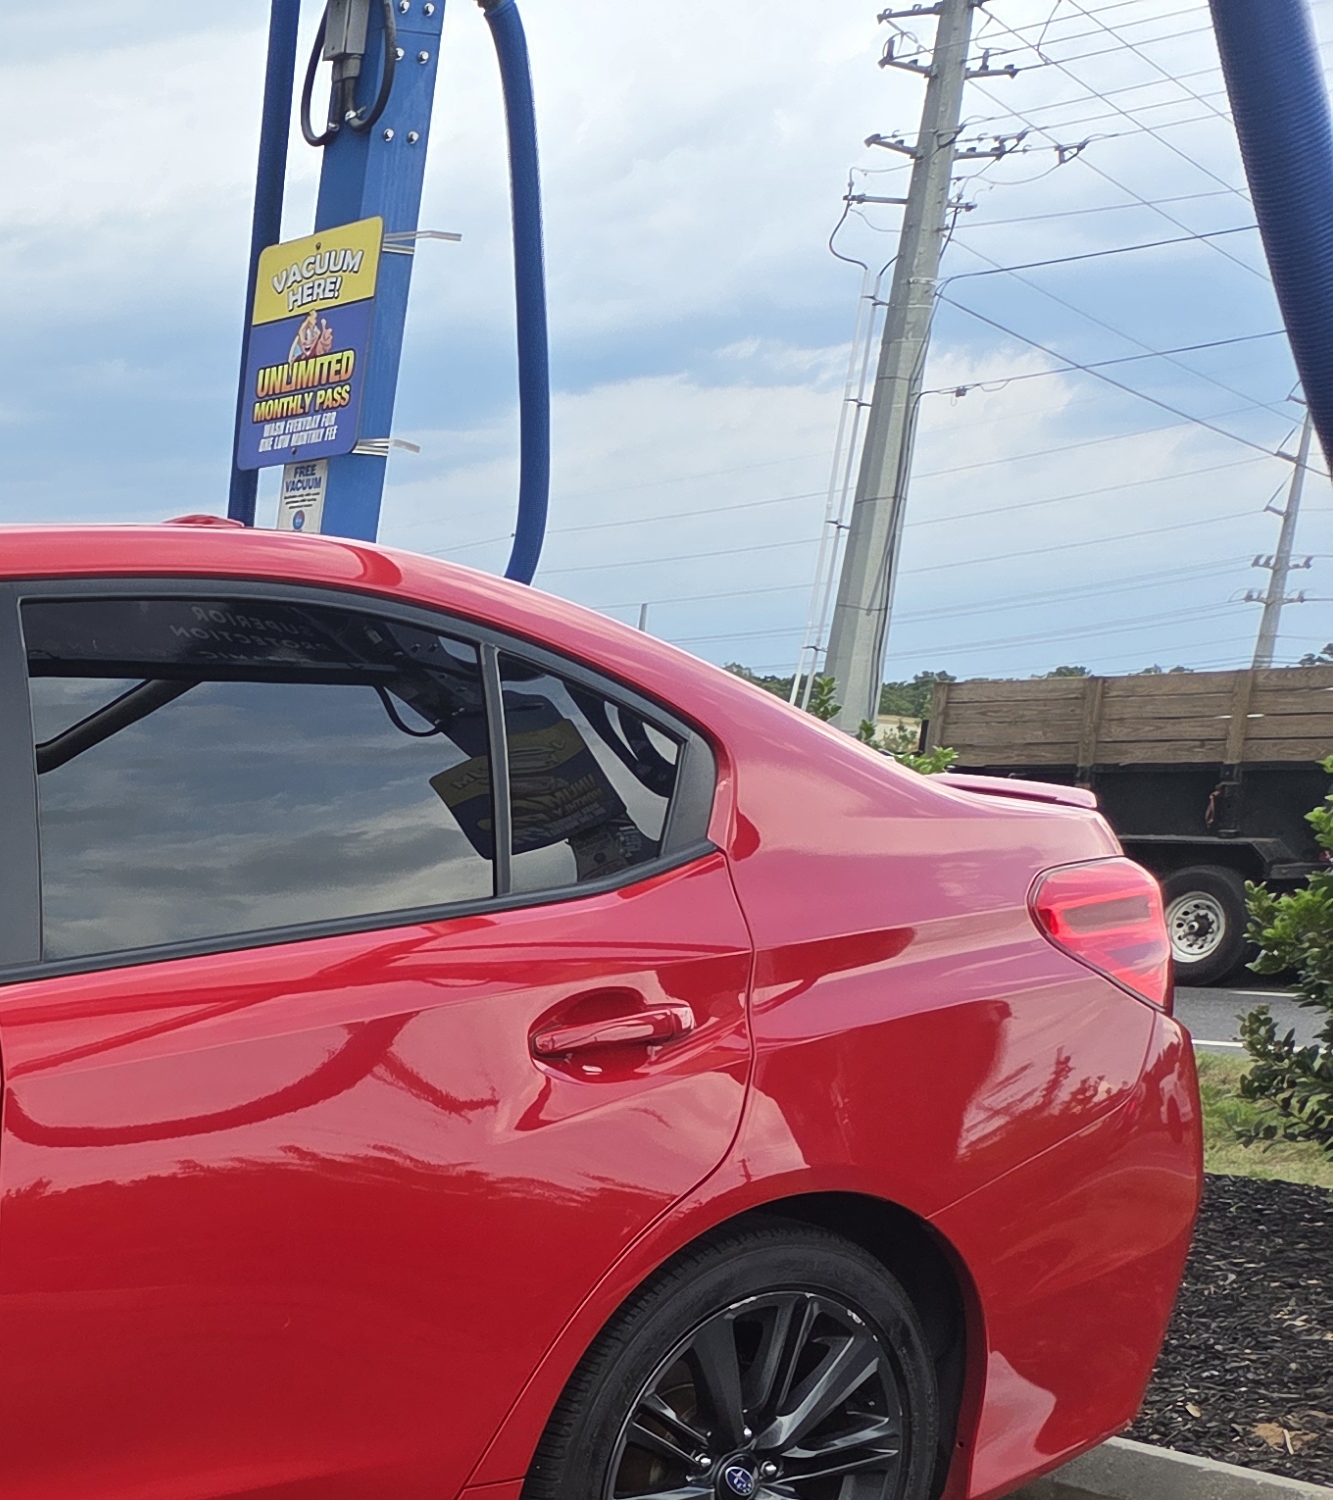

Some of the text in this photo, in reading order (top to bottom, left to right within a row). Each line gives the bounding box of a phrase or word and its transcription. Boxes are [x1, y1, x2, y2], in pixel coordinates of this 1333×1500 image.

[272, 249, 364, 294] VACUUM
[288, 275, 342, 312] HERE!
[256, 350, 355, 398] UNLIMITED
[253, 384, 350, 422] MONTHLY PASS
[285, 476, 322, 493] VACUUM
[294, 464, 318, 479] FREE
